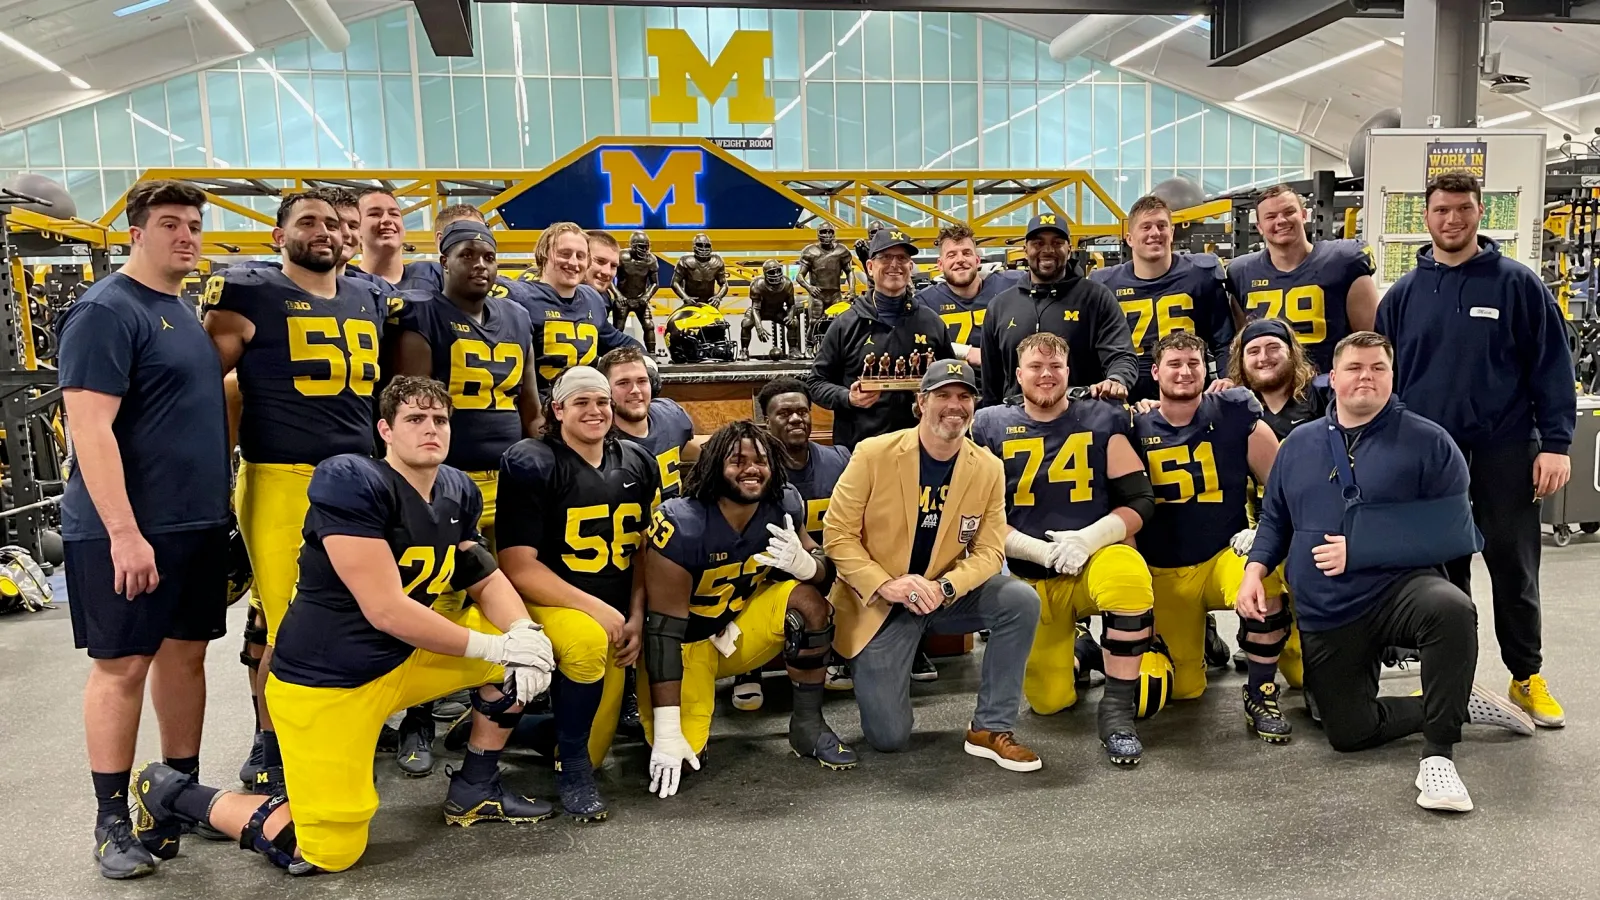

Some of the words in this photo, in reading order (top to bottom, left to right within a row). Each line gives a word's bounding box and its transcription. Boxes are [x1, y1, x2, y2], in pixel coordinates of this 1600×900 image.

[647, 28, 775, 124] M
[714, 139, 748, 148] WEIGHT
[748, 139, 772, 148] ROOM
[1429, 153, 1467, 167] WORK
[1470, 153, 1485, 167] IN
[600, 149, 706, 226] M
[889, 231, 904, 241] M
[1039, 214, 1056, 226] M
[914, 333, 928, 345] M
[1063, 310, 1080, 322] M
[1120, 293, 1196, 357] 76
[1246, 285, 1327, 344] 79
[286, 316, 381, 397] 58
[450, 338, 524, 411] 62
[538, 320, 599, 380] 52
[946, 363, 963, 375] M
[1002, 431, 1094, 507] 74
[1146, 441, 1224, 504] 51
[561, 503, 642, 573] 56
[647, 510, 676, 549] 53
[256, 771, 269, 784] M
